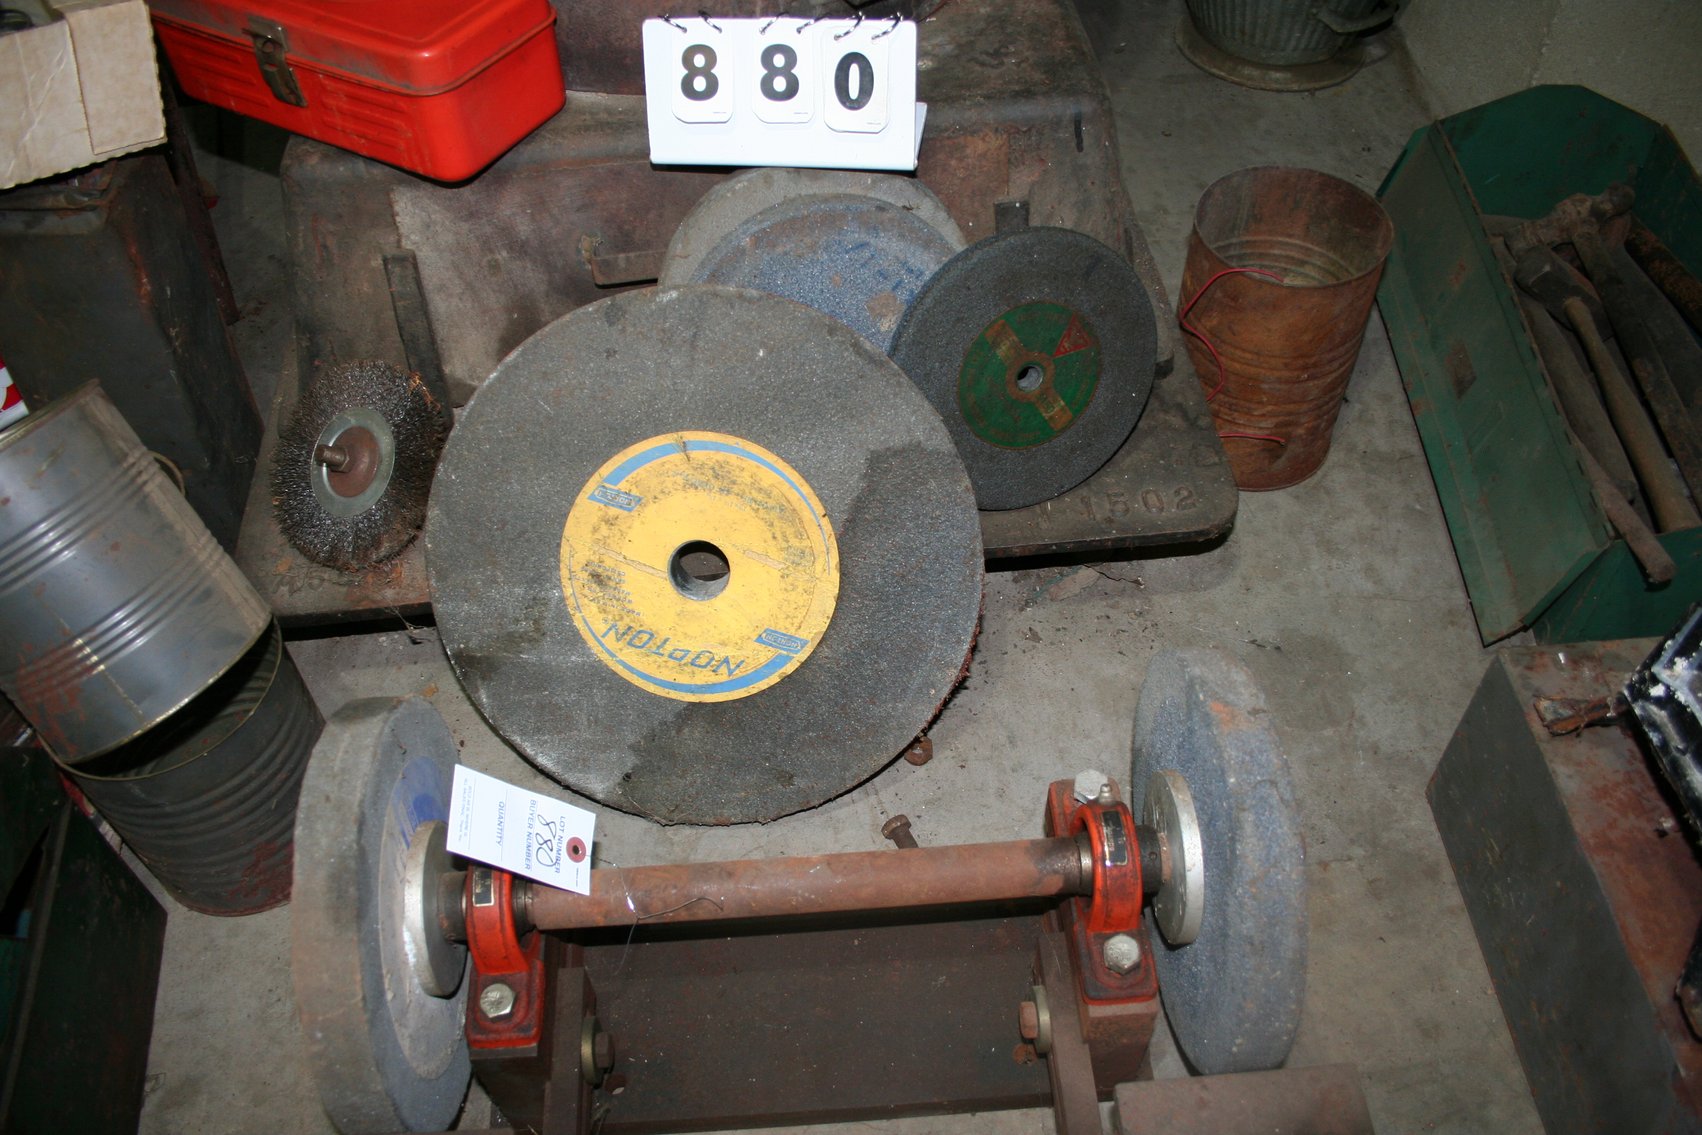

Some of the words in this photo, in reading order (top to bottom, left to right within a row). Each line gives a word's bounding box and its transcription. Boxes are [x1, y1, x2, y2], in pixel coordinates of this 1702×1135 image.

[601, 622, 745, 676] NORTON
[496, 801, 505, 847] QUANTITY
[527, 799, 537, 830] BUYER
[524, 832, 533, 871] NUMBER
[535, 814, 558, 868] 880
[555, 835, 563, 874] NUMBER
